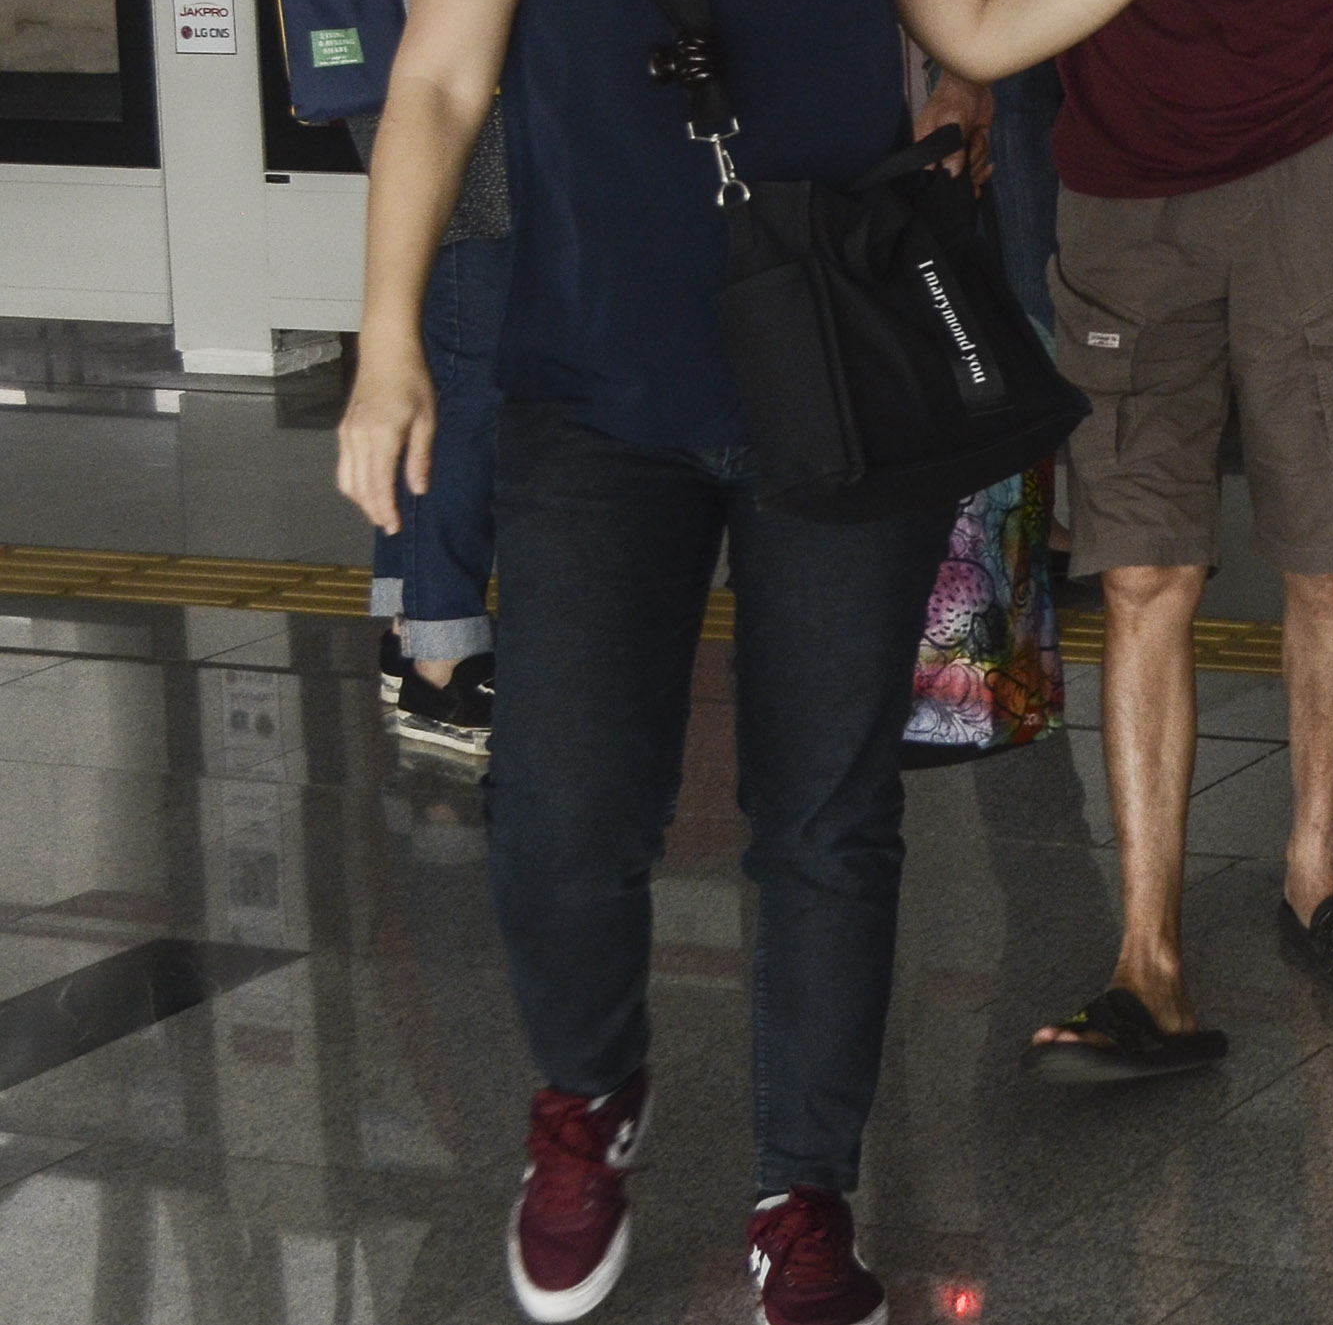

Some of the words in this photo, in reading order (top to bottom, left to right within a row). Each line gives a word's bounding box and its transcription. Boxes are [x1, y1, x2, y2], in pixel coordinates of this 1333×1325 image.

[179, 5, 229, 18] JAKPRO
[194, 27, 208, 38] LG
[209, 27, 230, 39] CNS
[918, 259, 934, 270] I
[923, 271, 976, 351] marymond
[961, 353, 986, 384] you
